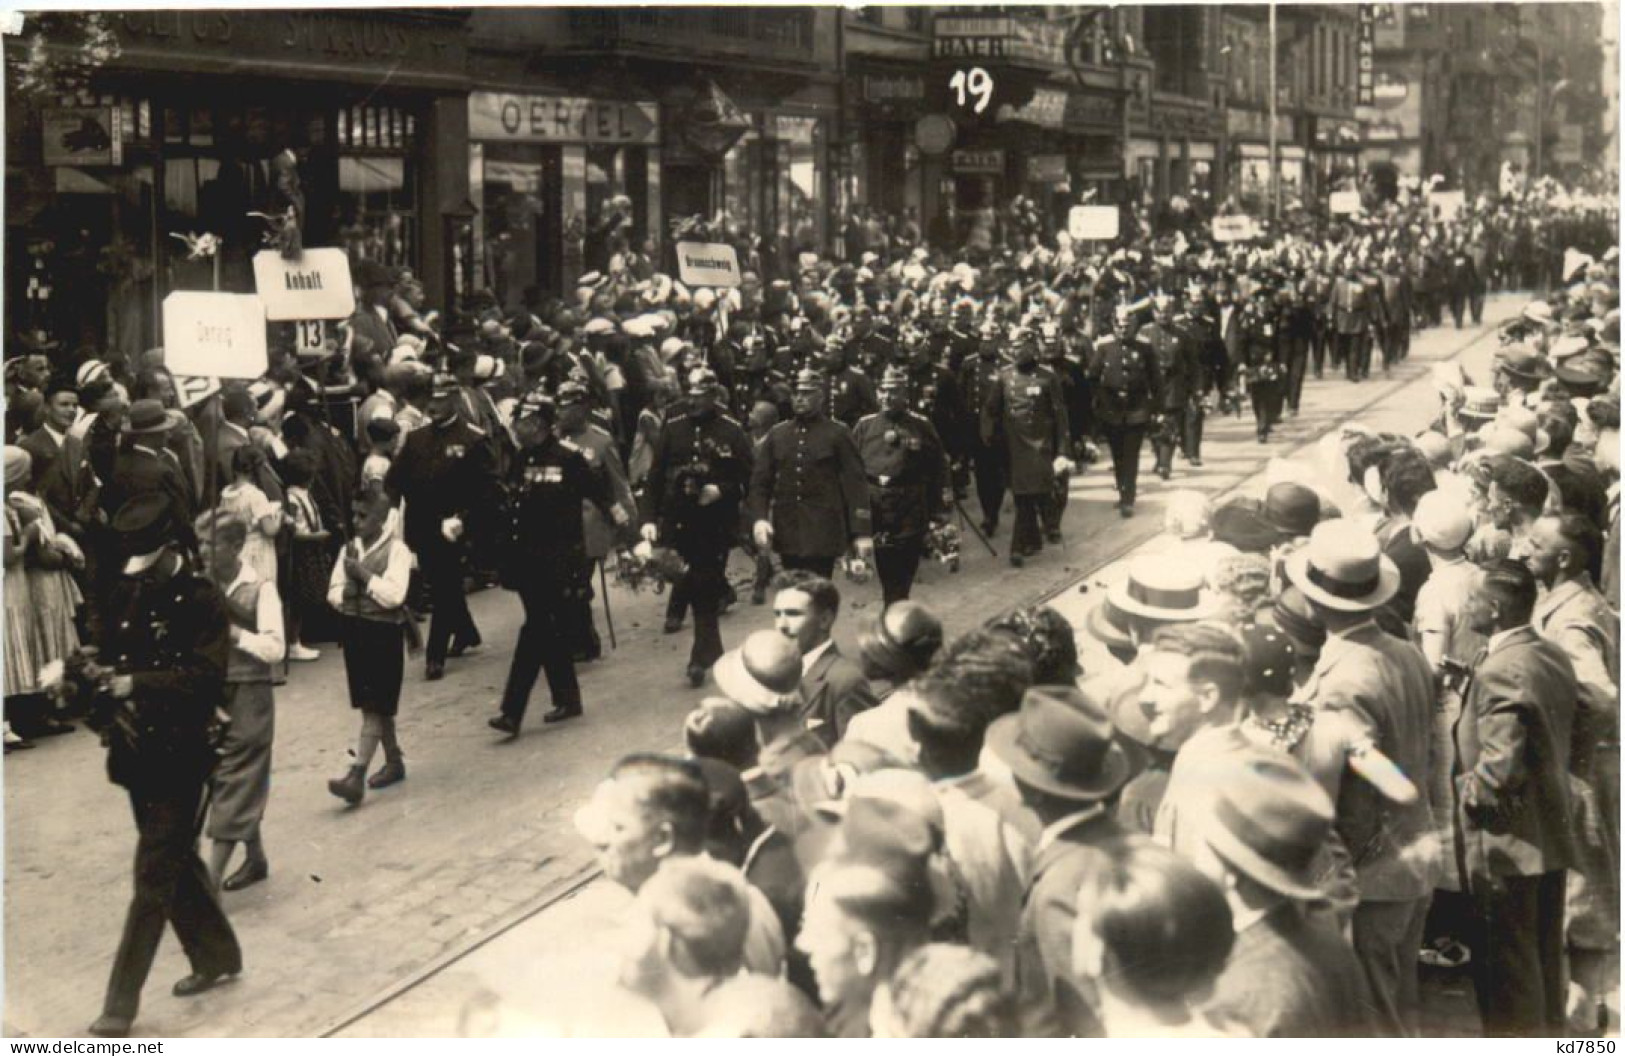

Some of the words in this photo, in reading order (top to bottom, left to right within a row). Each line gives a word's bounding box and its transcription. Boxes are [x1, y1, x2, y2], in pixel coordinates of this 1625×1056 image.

[502, 100, 632, 138] OERTEL
[284, 271, 323, 290] Anhalt
[303, 319, 322, 347] 13
